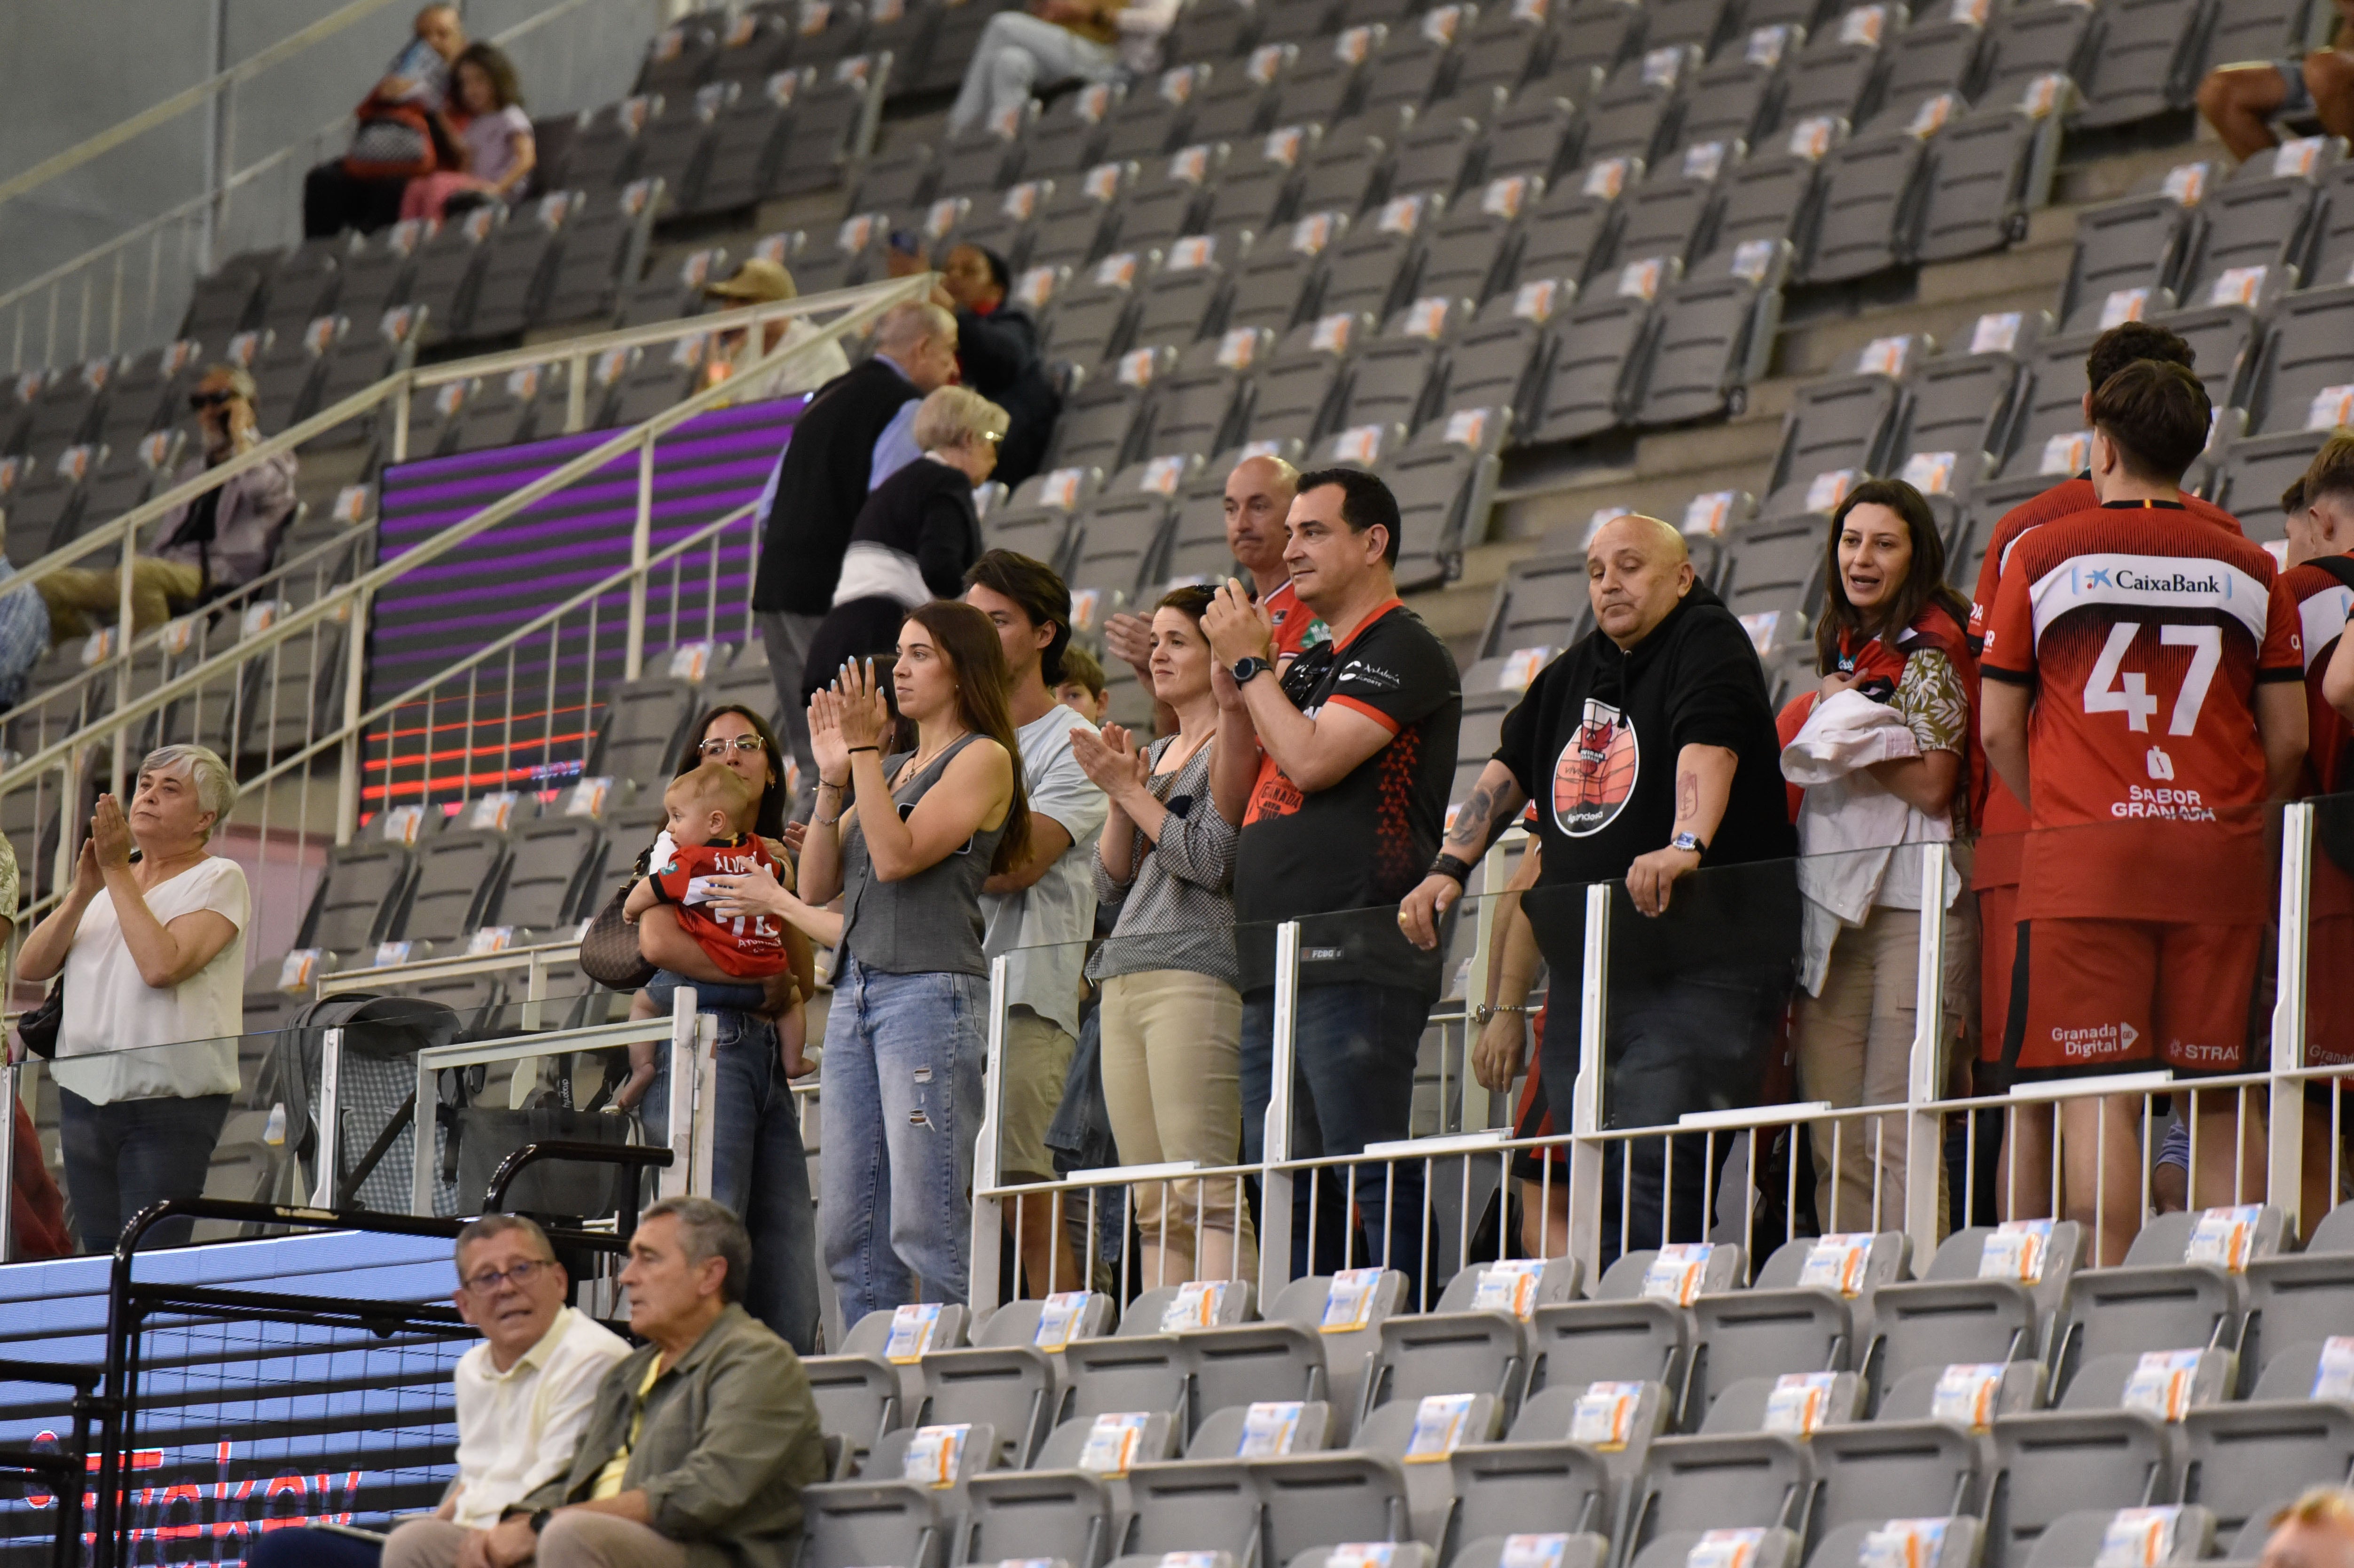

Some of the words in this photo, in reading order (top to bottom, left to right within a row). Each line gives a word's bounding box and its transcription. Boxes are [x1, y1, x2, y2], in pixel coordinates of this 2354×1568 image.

[2116, 570, 2220, 593] CaixaBank
[2084, 622, 2222, 737] 47
[2130, 784, 2202, 805] SABOR
[2111, 802, 2216, 822] GRANADA
[2052, 1023, 2117, 1042] Granada
[2065, 1037, 2118, 1058] Digital
